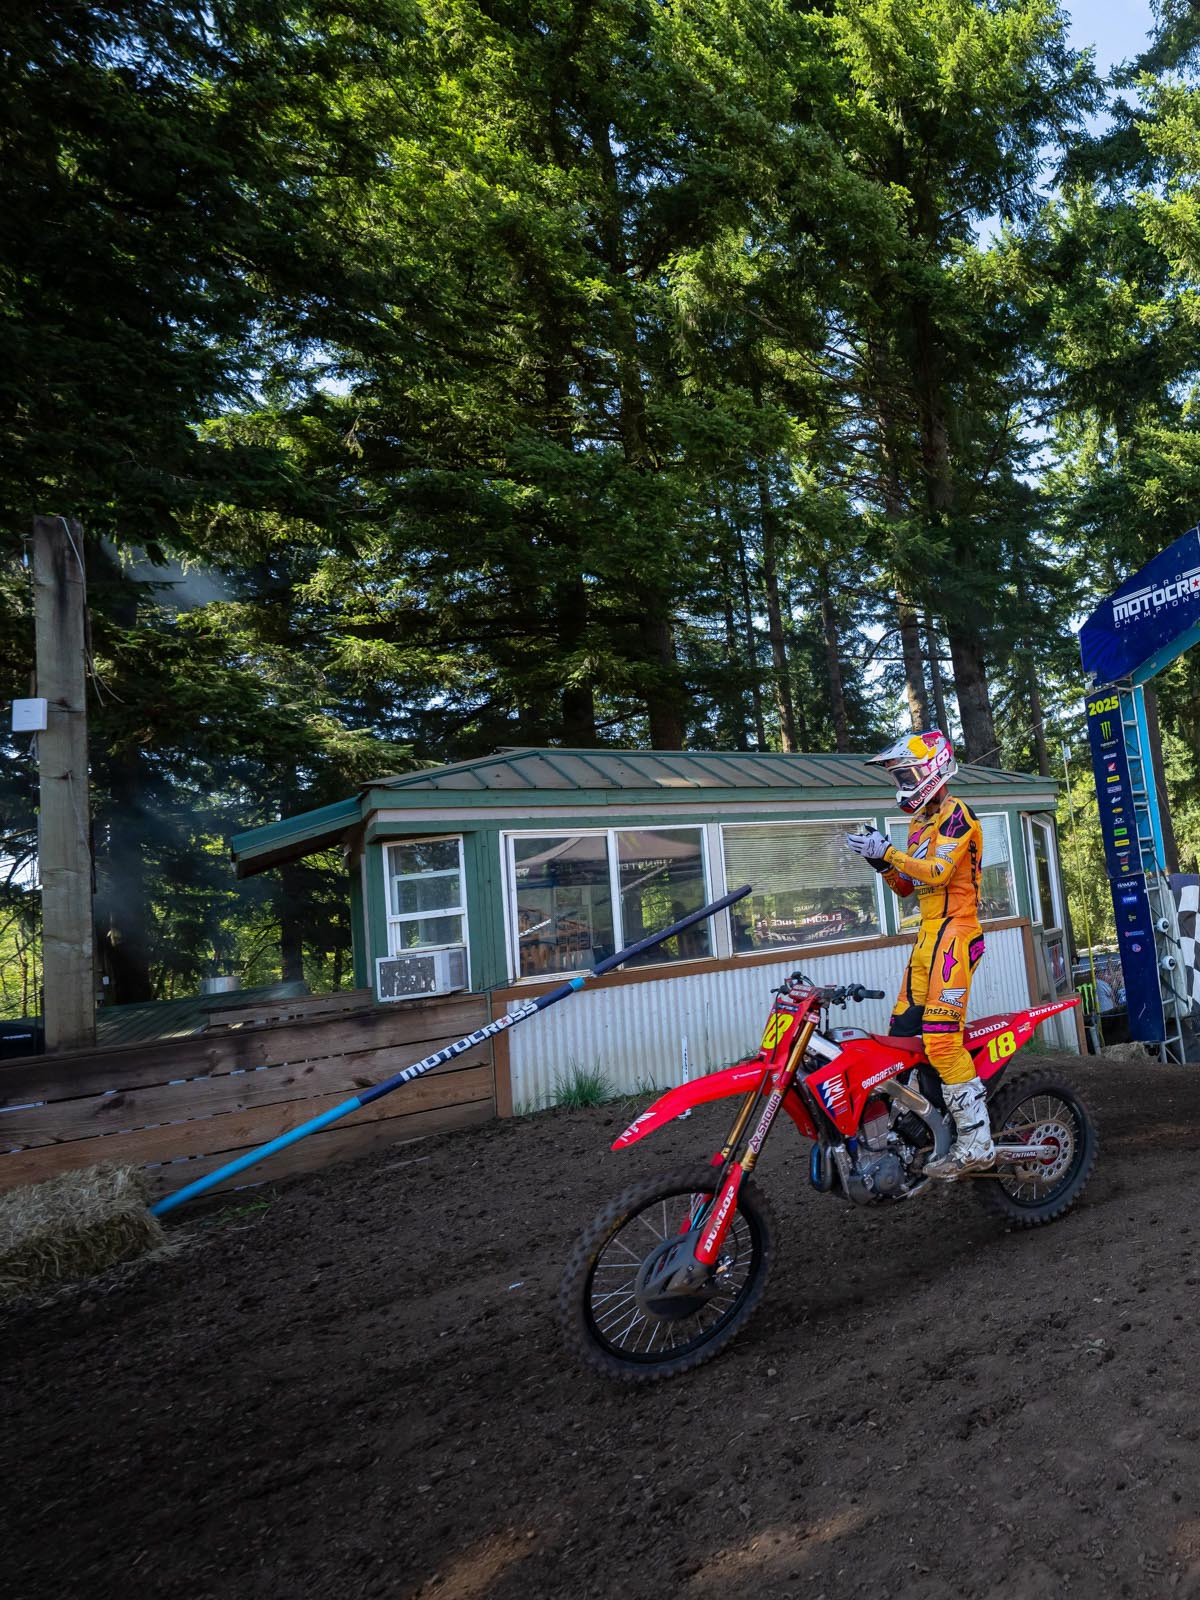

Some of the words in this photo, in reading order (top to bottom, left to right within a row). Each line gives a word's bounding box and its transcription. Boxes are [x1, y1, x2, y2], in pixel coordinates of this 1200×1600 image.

[1151, 574, 1182, 591] PRO
[1088, 695, 1120, 717] 2025
[938, 995, 964, 1009] HONDA
[1029, 1003, 1065, 1018] DUNLOP
[399, 1001, 539, 1081] MOTOCROSS
[968, 1021, 1010, 1040] HONDA
[986, 1030, 1018, 1063] 18
[758, 1093, 782, 1136] SHOWA
[705, 1185, 734, 1253] DUNLOP
